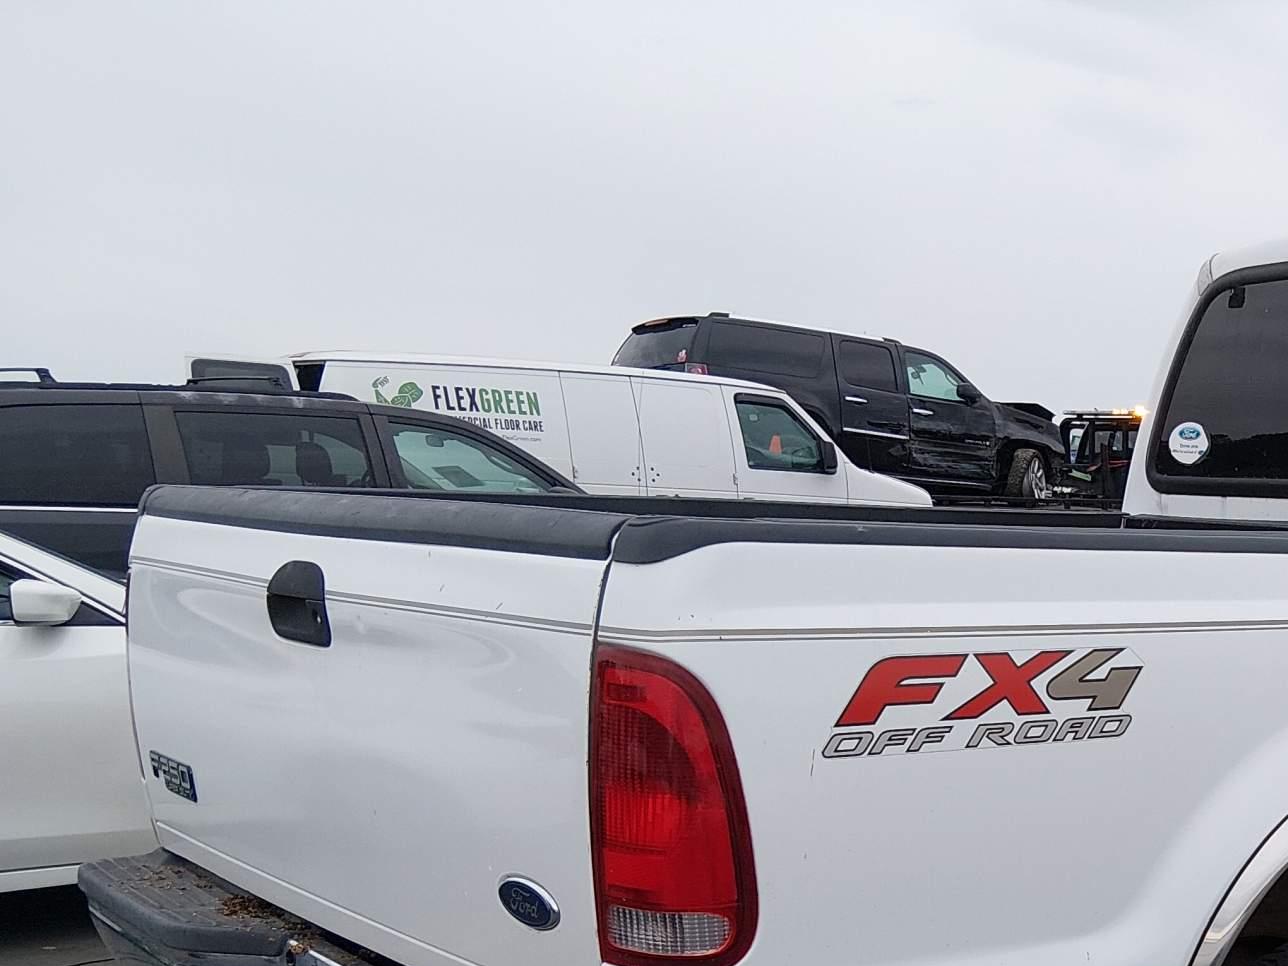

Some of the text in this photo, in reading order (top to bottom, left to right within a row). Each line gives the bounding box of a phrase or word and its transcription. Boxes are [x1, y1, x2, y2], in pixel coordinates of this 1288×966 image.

[431, 385, 541, 416] FLEXGREEN
[495, 418, 521, 431] FLOOR
[522, 420, 544, 433] CARE
[834, 648, 1144, 727] FX4
[822, 714, 1132, 758] OFF ROAD
